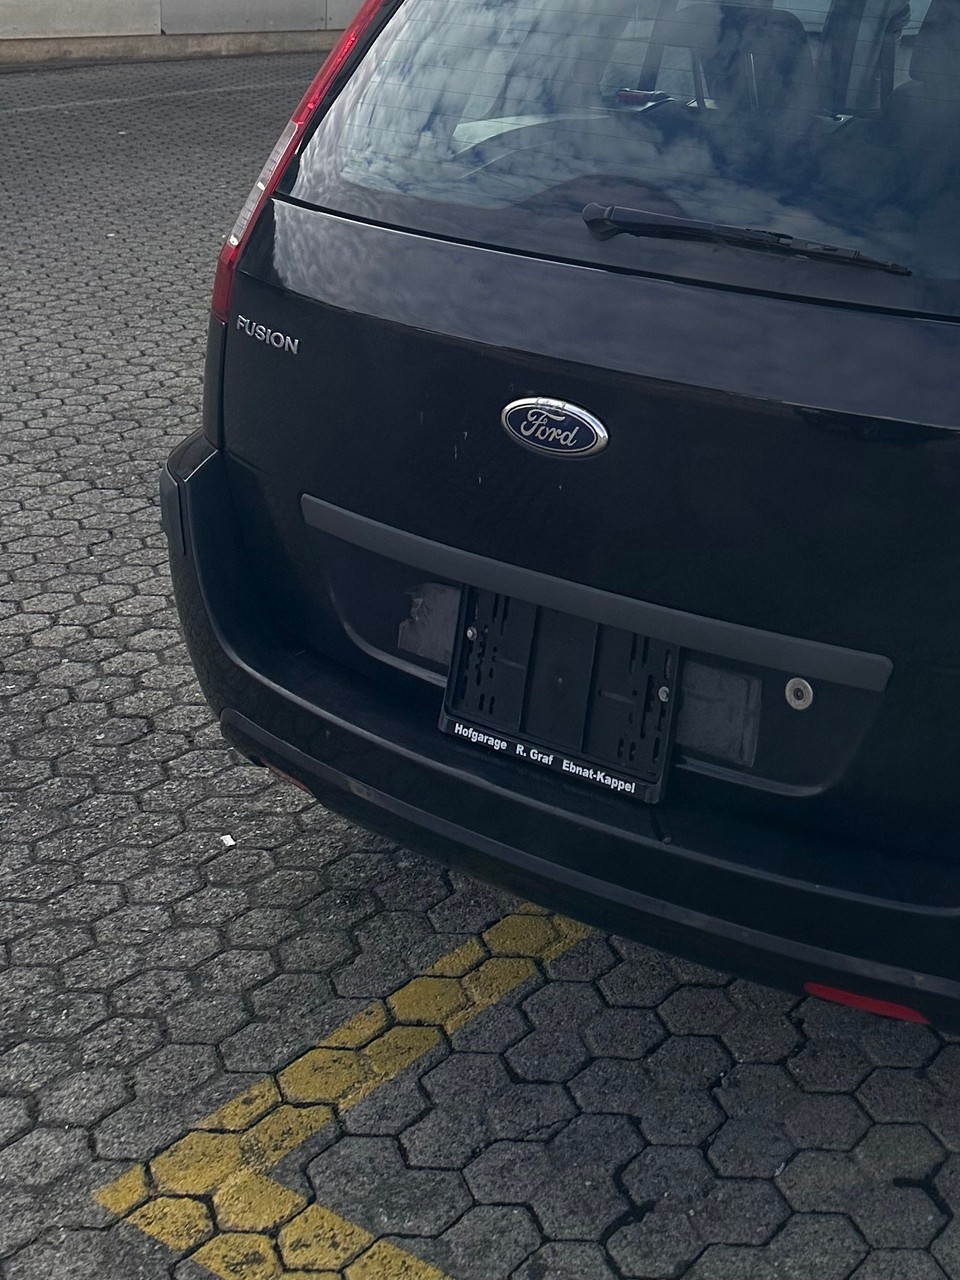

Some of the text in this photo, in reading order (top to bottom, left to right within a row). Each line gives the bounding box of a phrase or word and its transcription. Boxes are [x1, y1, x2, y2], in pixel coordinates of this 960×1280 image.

[236, 314, 299, 355] FUSION
[520, 408, 580, 448] Ford
[454, 722, 636, 794] Hofgarage R. Graf Ebnat-Kappel
